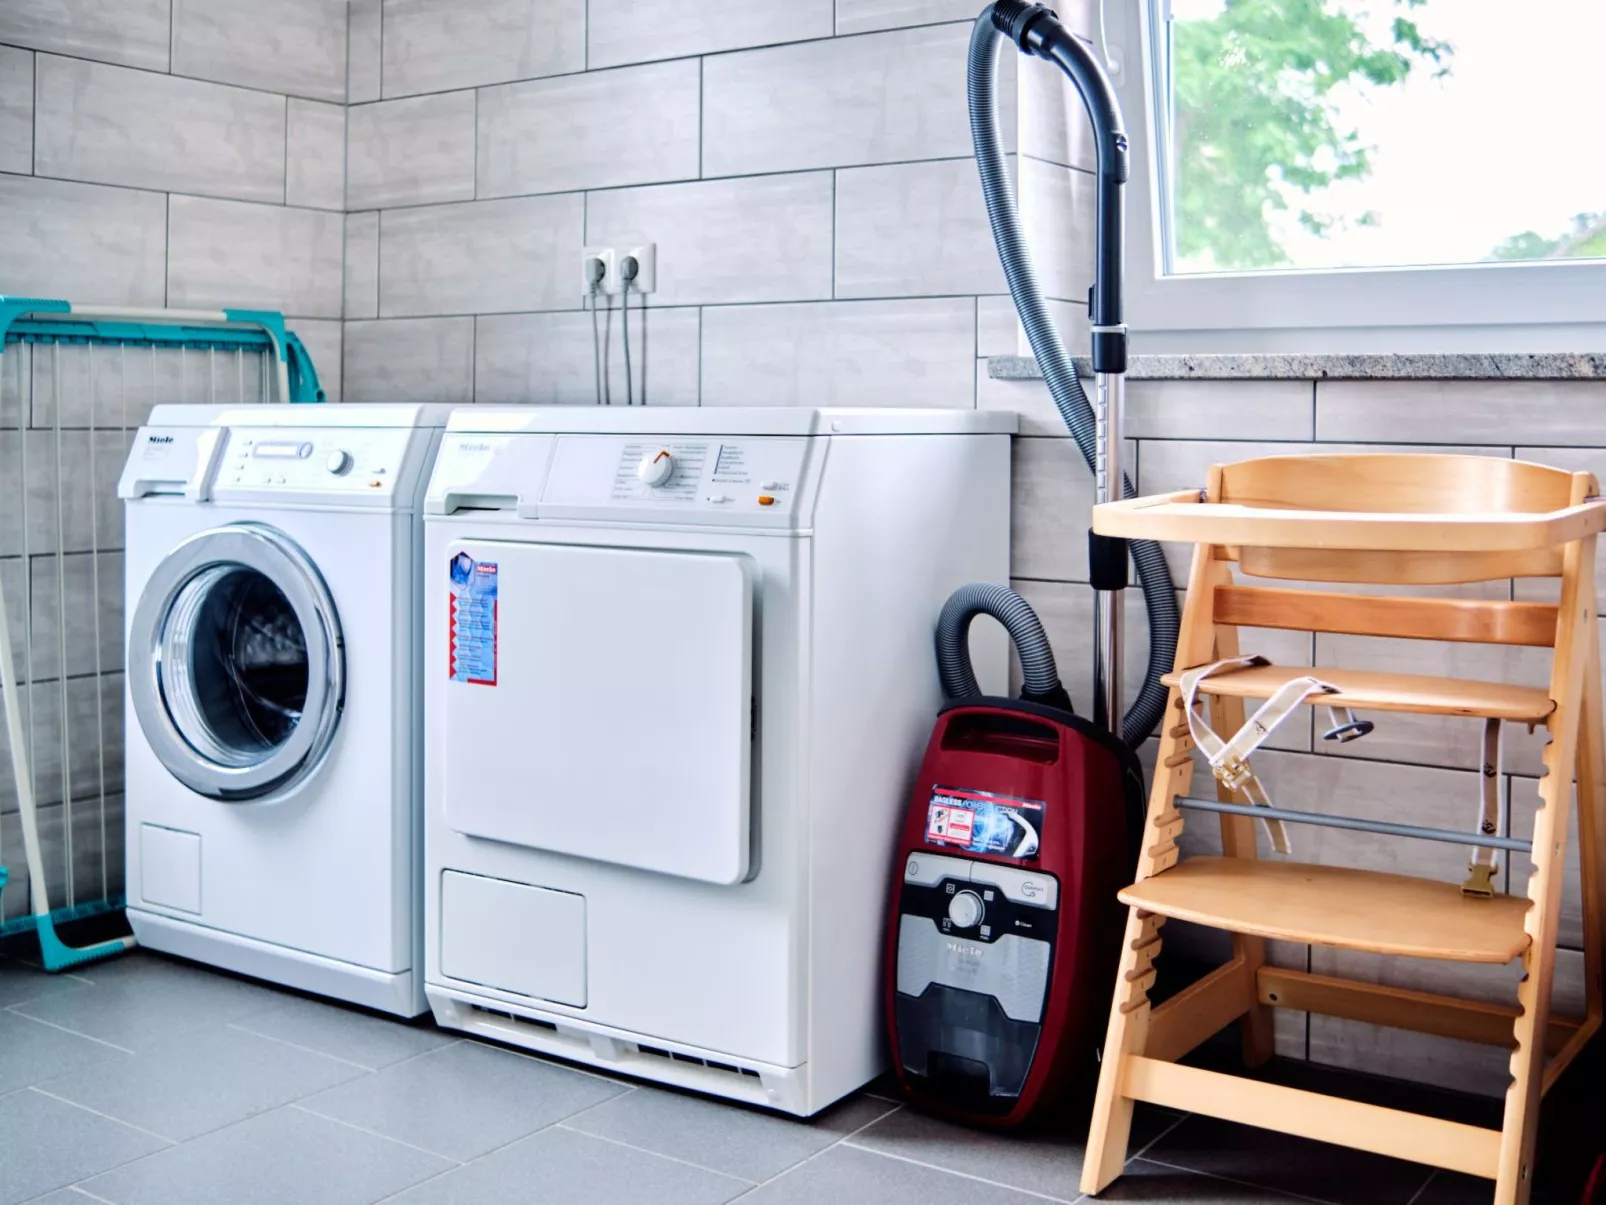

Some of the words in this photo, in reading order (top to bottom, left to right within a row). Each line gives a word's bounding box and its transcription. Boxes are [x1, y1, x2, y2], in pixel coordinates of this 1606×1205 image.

[149, 436, 174, 444] Miele
[934, 795, 963, 806] BAGLESS
[947, 942, 983, 957] Miele
